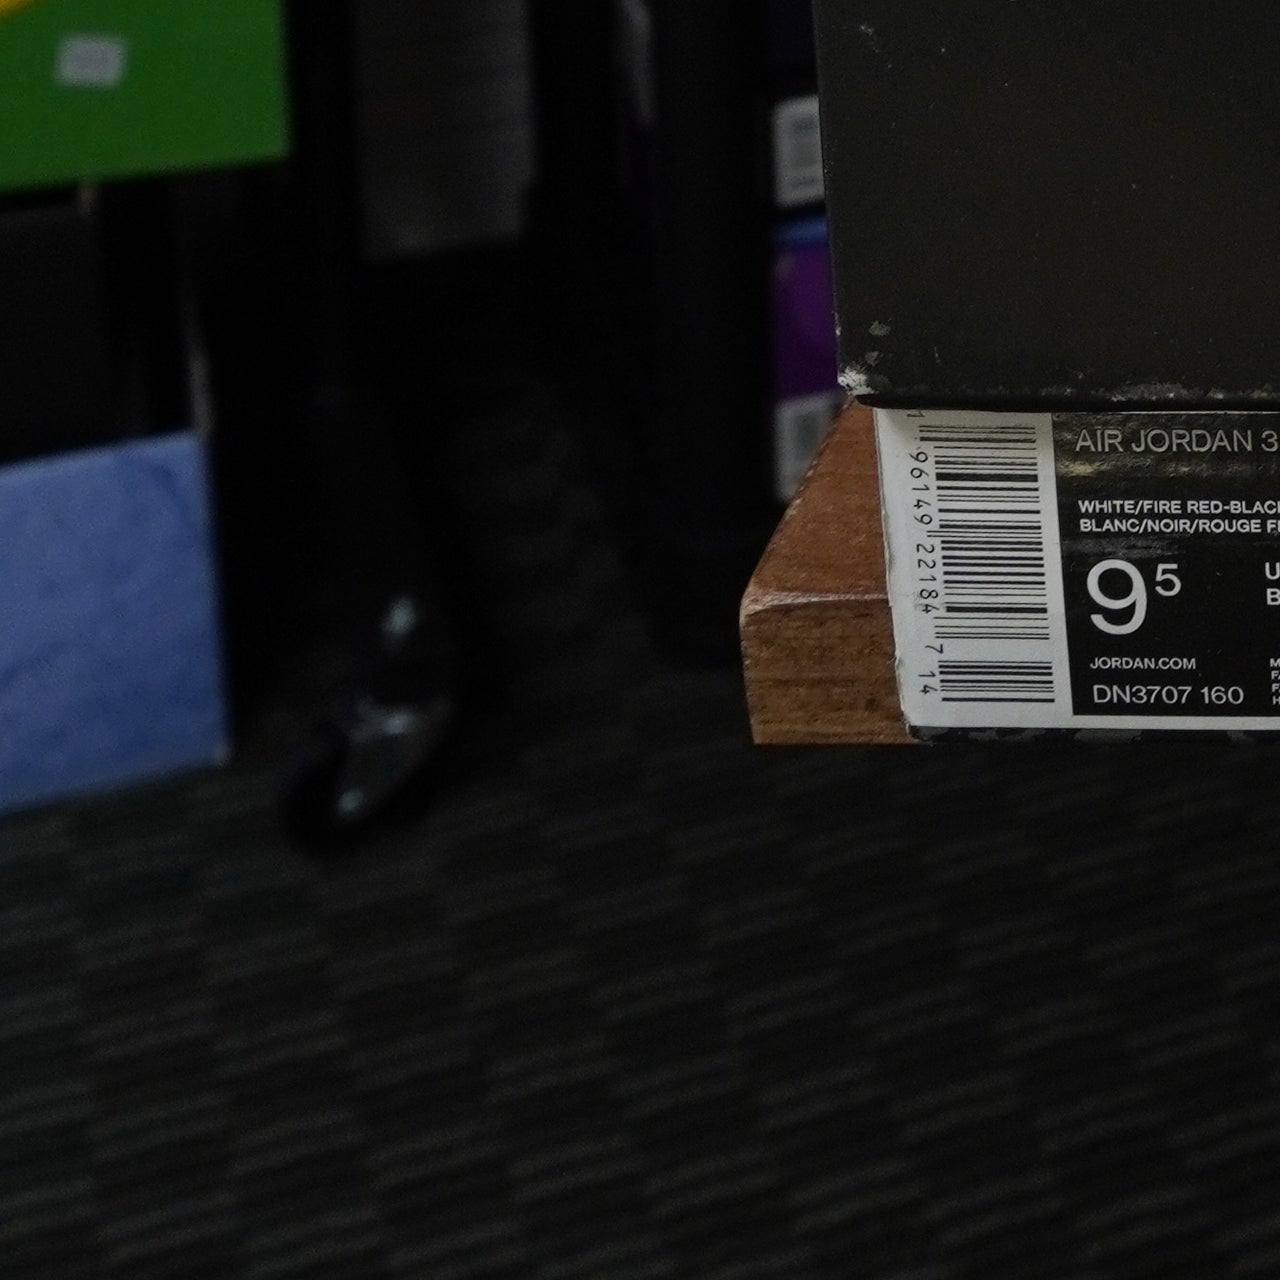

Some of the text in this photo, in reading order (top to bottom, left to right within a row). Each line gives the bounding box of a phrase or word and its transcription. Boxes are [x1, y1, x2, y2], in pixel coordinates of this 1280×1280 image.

[1075, 429, 1124, 453] AIR
[1130, 429, 1252, 453] JORDAN
[1260, 430, 1279, 452] 3
[909, 451, 934, 526] 96149
[1077, 499, 1182, 516] WHITE/FIRE
[1079, 518, 1262, 534] BLANC/NOIR/ROUGE
[916, 543, 941, 614] 22184
[1089, 656, 1197, 670] JORDAN.COM
[918, 670, 939, 695] 14
[1092, 684, 1245, 705] DN3707 160
